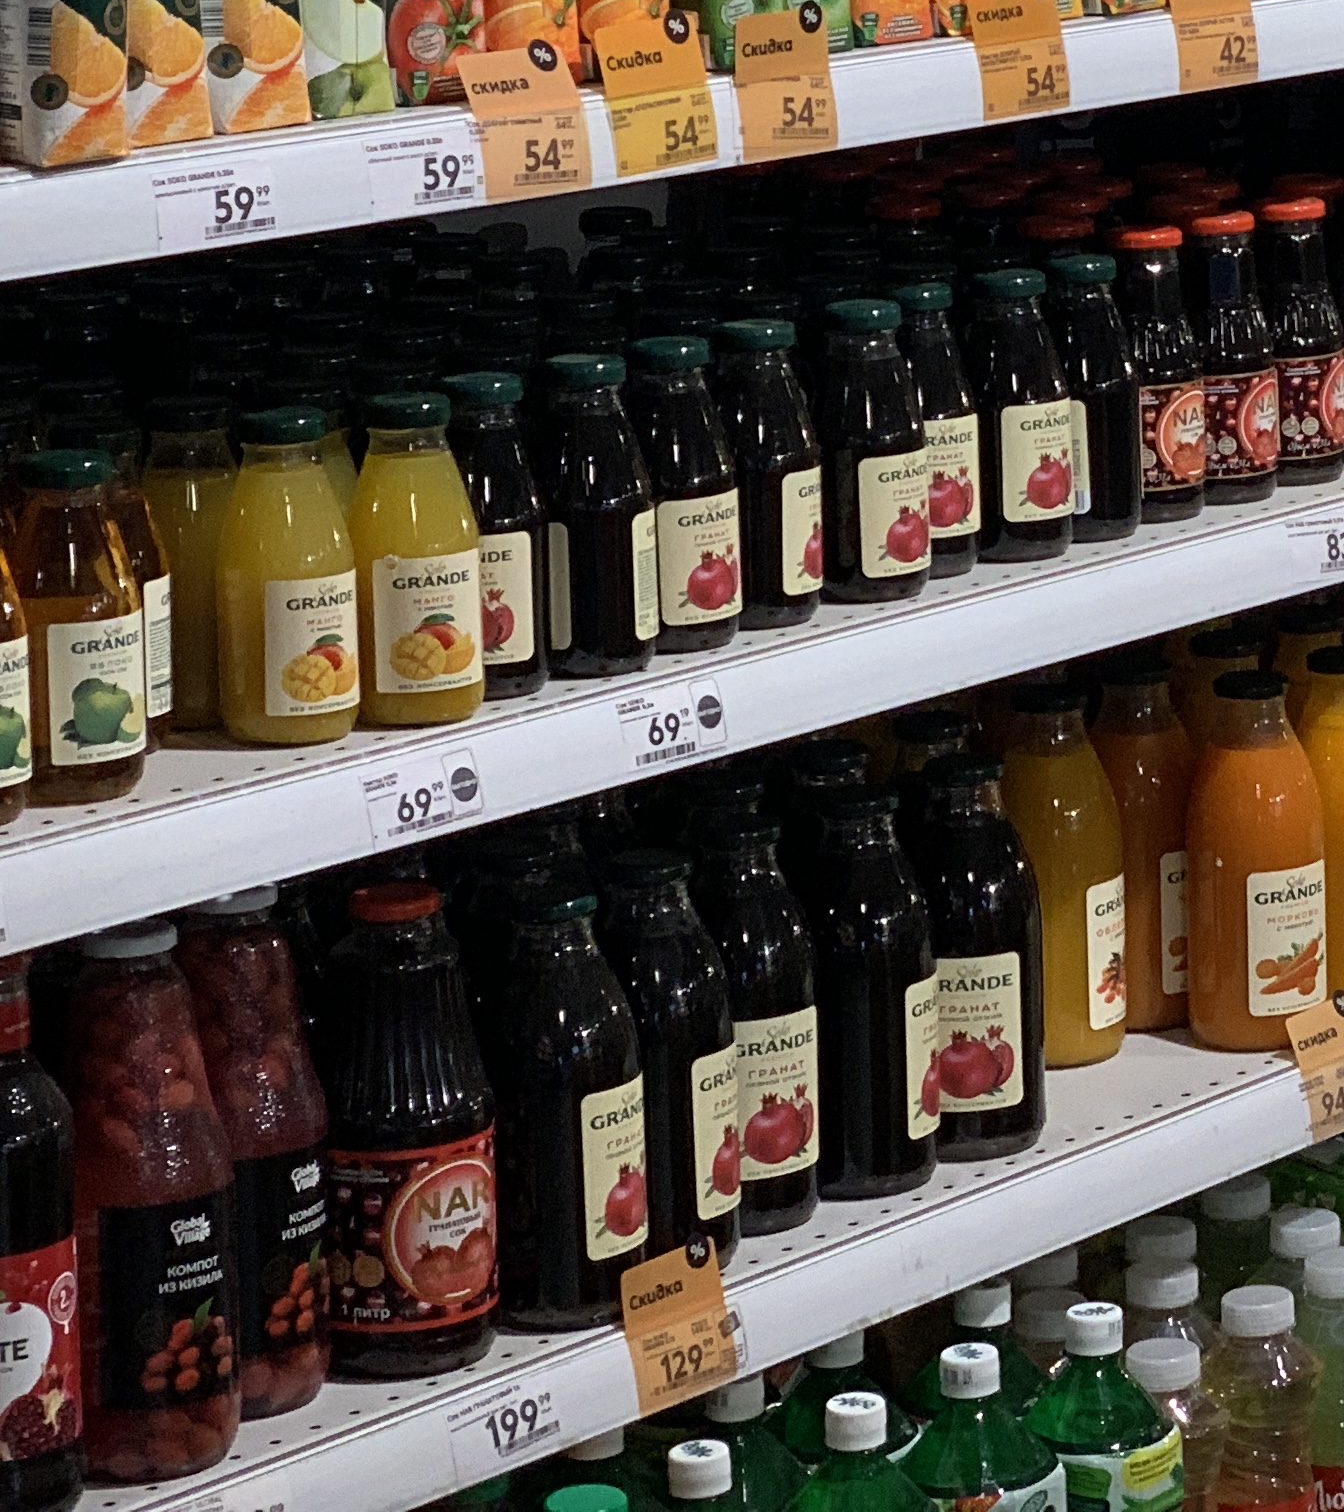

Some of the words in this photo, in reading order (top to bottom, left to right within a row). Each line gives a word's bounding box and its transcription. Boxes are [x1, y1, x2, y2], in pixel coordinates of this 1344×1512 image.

[742, 38, 793, 58] Скидка
[1219, 35, 1246, 64] 42
[606, 52, 663, 72] Скидка
[782, 96, 814, 127] 54
[814, 99, 827, 110] 99
[525, 138, 561, 172] 54
[423, 156, 460, 190] 59
[461, 154, 474, 166] 99
[214, 187, 254, 224] 59
[256, 185, 270, 197] 99
[678, 506, 737, 528] GRANDE
[694, 529, 730, 541] ГРАНАТ
[392, 569, 470, 590] GRANDE
[412, 594, 456, 607] МАНГО
[648, 713, 680, 746] 69
[397, 787, 432, 823] 69
[431, 781, 444, 793] 99
[1254, 880, 1323, 906] GRANDE
[748, 1059, 806, 1079] ГРАНАТ
[167, 1256, 219, 1279] КОМПОТ
[158, 1278, 177, 1295] ИЗ
[179, 1268, 224, 1291] КИЗИЛА
[629, 1279, 683, 1311] Скидка
[353, 1305, 391, 1322] литр
[660, 1344, 702, 1385] 129
[484, 1402, 537, 1450] 199
[537, 1393, 551, 1408] 99
